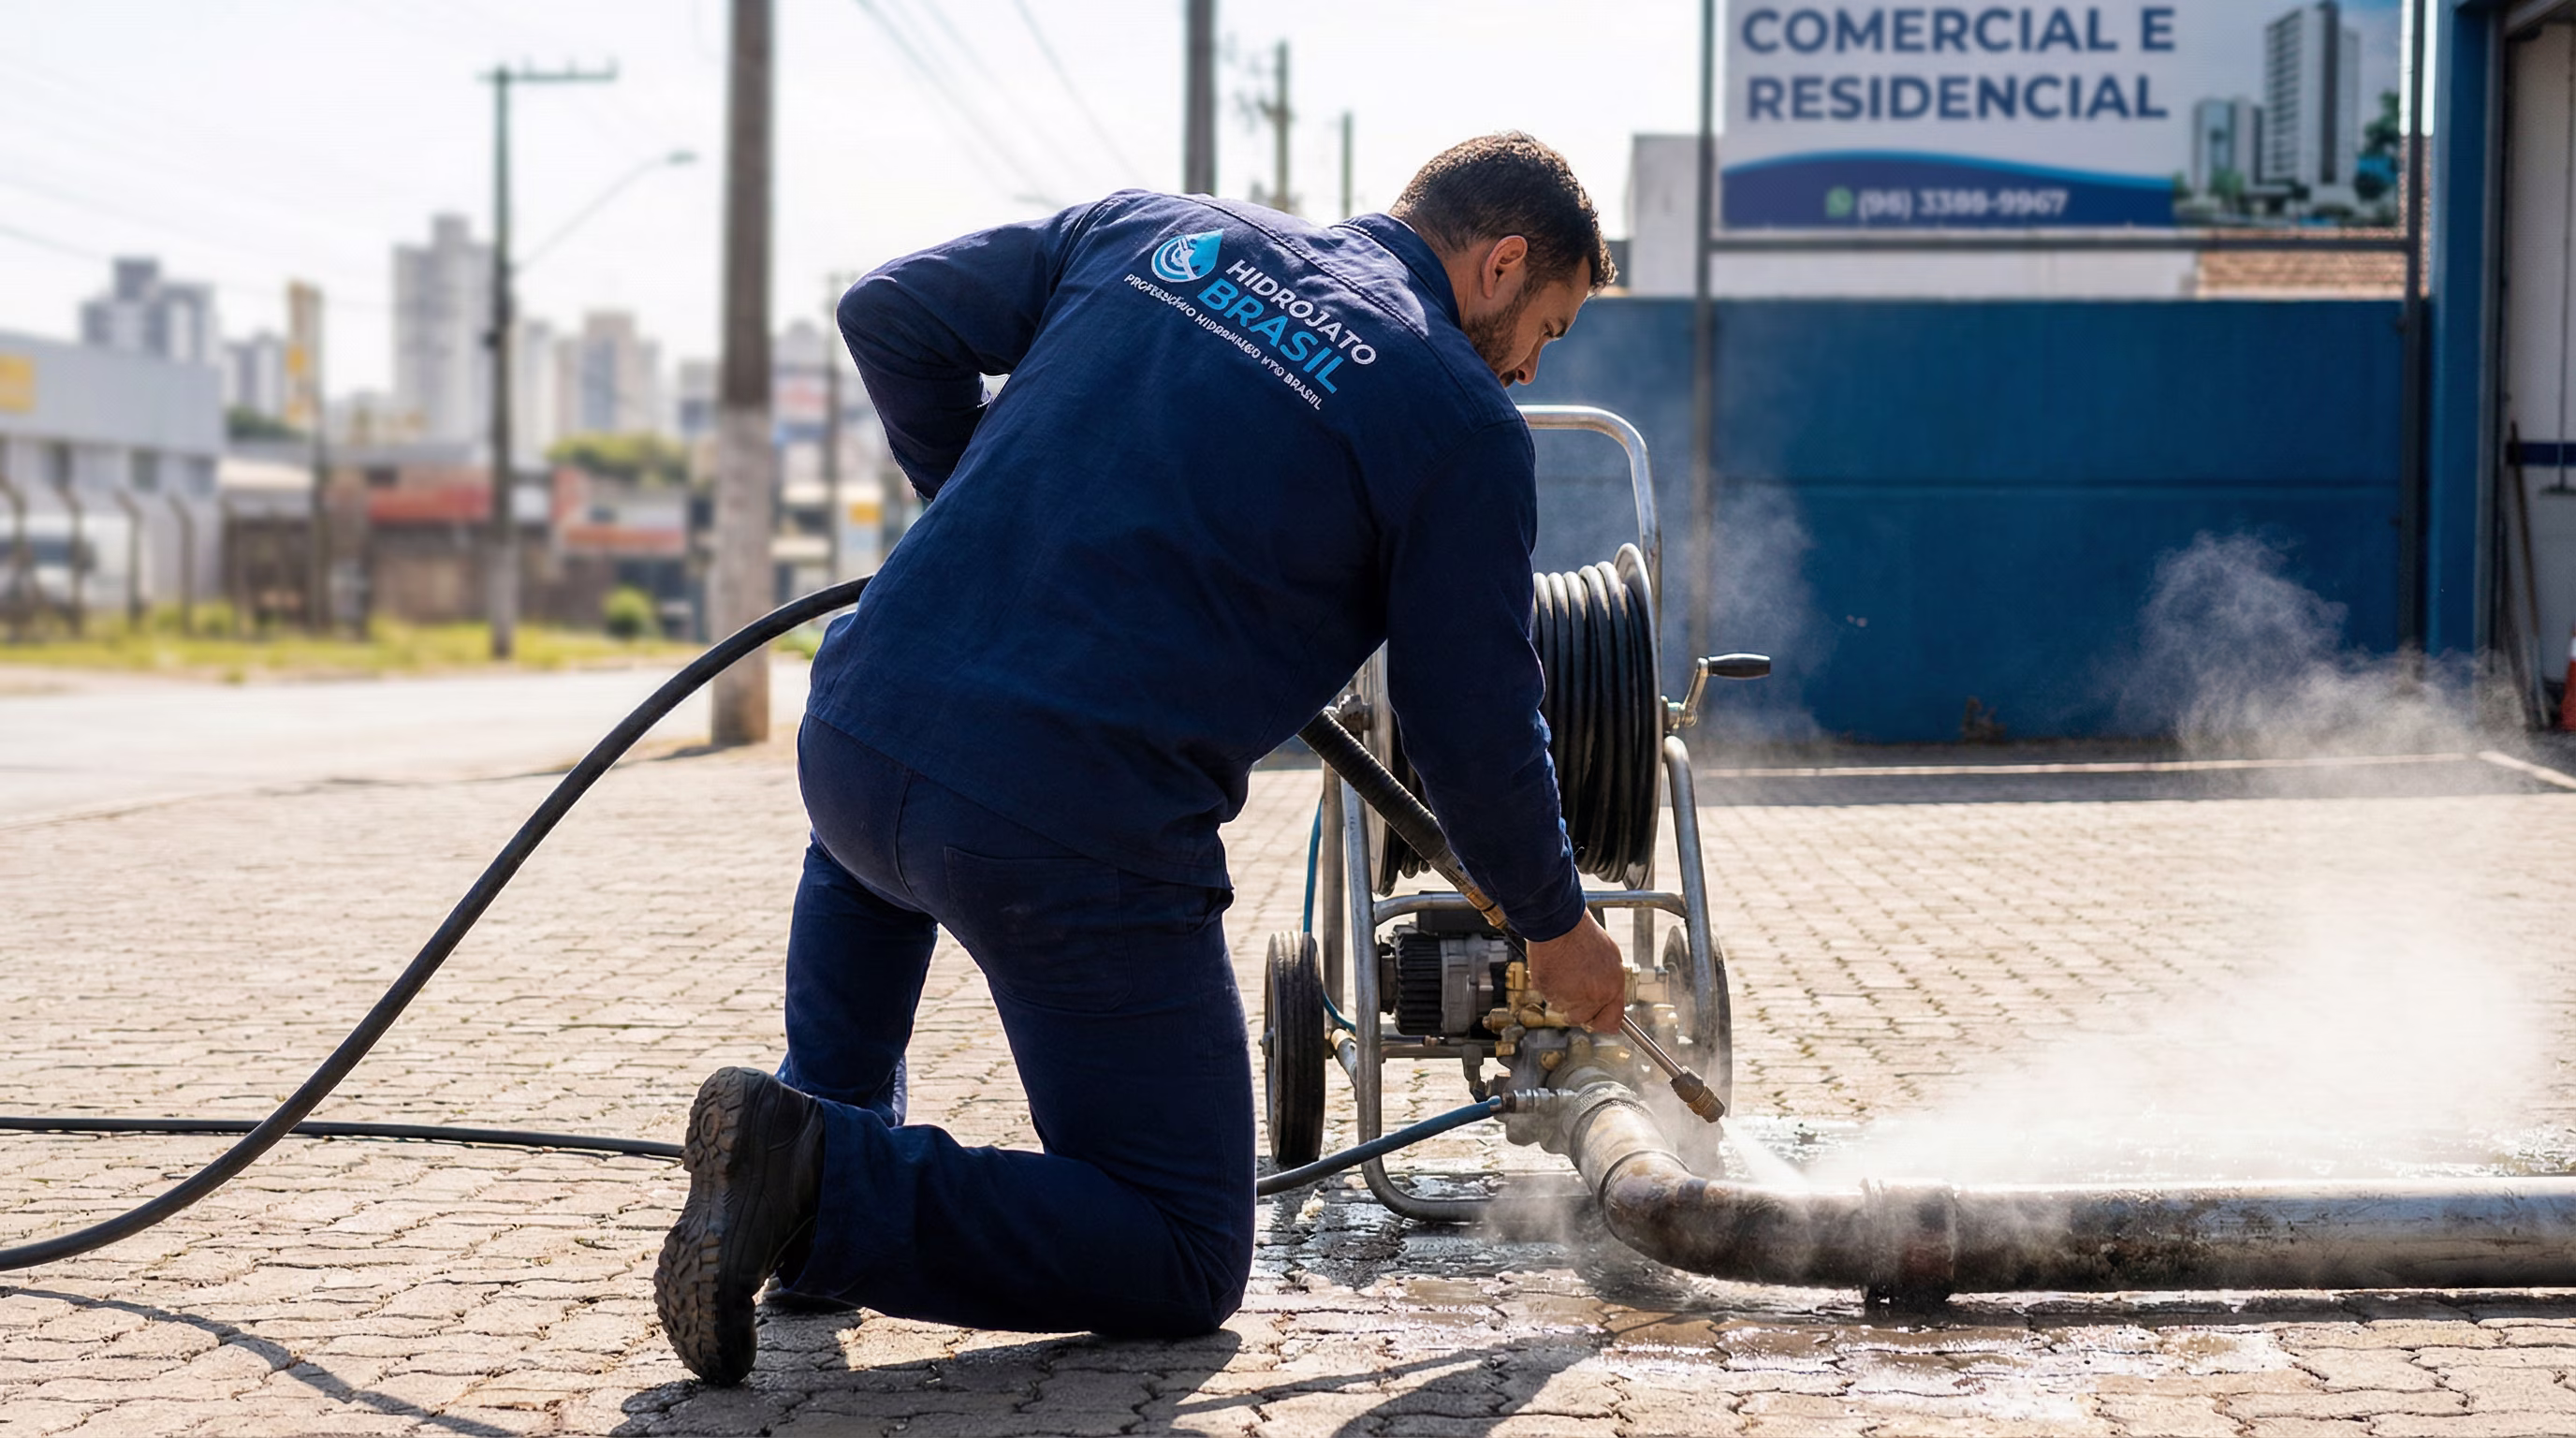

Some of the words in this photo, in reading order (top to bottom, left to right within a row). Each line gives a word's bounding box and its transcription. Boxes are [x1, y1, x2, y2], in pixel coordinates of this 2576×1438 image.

[1741, 7, 2118, 53] COMERCIAL
[2141, 7, 2175, 51] E
[1748, 75, 2169, 120] RESIDENCIAL
[1196, 277, 1344, 394] BRASIL
[1226, 258, 1377, 365] HIDROJATO
